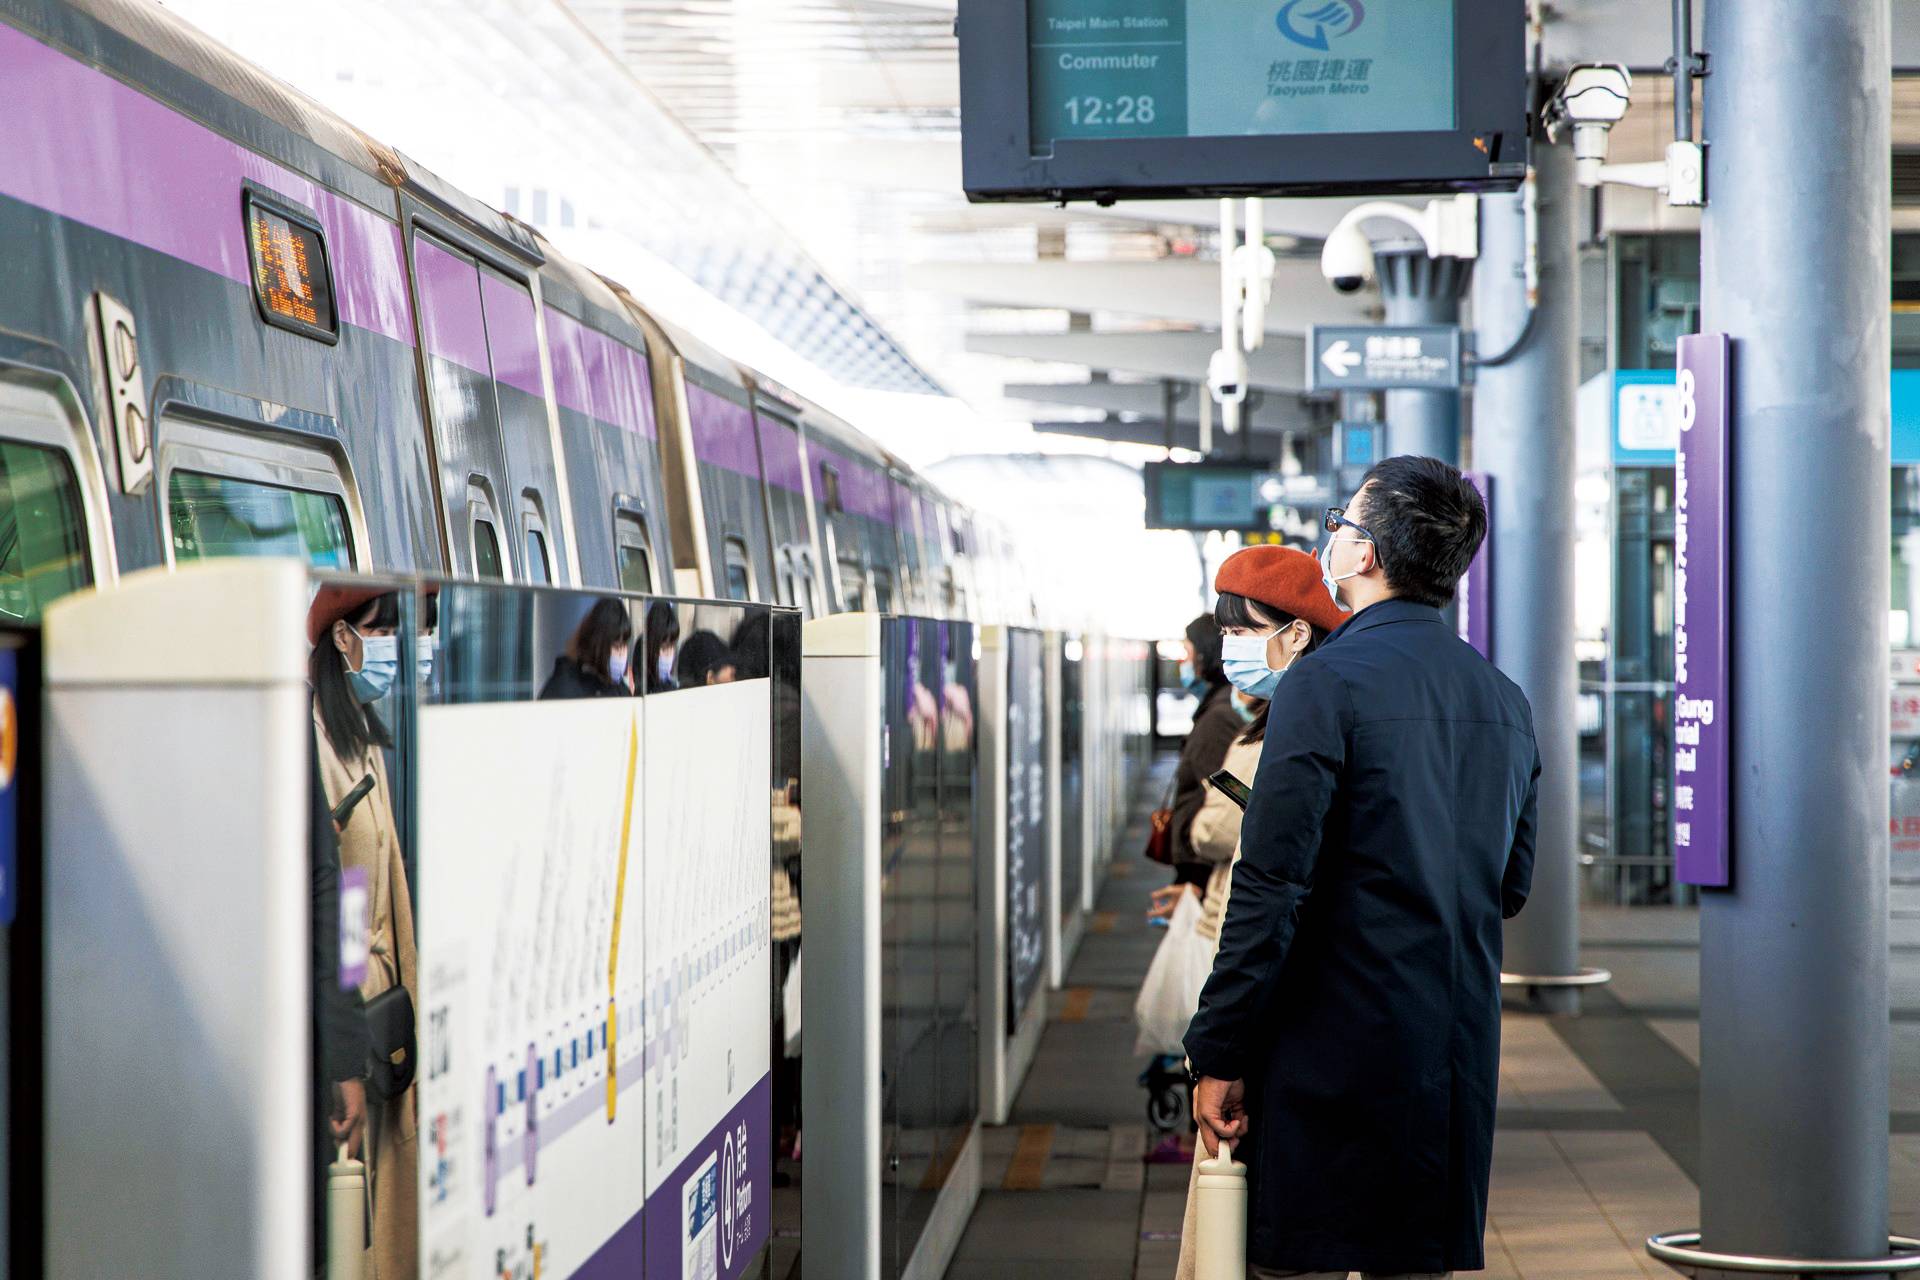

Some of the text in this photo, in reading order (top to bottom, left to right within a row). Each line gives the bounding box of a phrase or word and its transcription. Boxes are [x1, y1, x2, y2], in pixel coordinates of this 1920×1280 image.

[1048, 15, 1169, 31] Taipei Main Station
[1058, 52, 1159, 70] Commuter
[1266, 58, 1373, 81] 桃園捷運
[1266, 82, 1370, 98] Taoyuan Metro
[1064, 95, 1155, 125] 12:28
